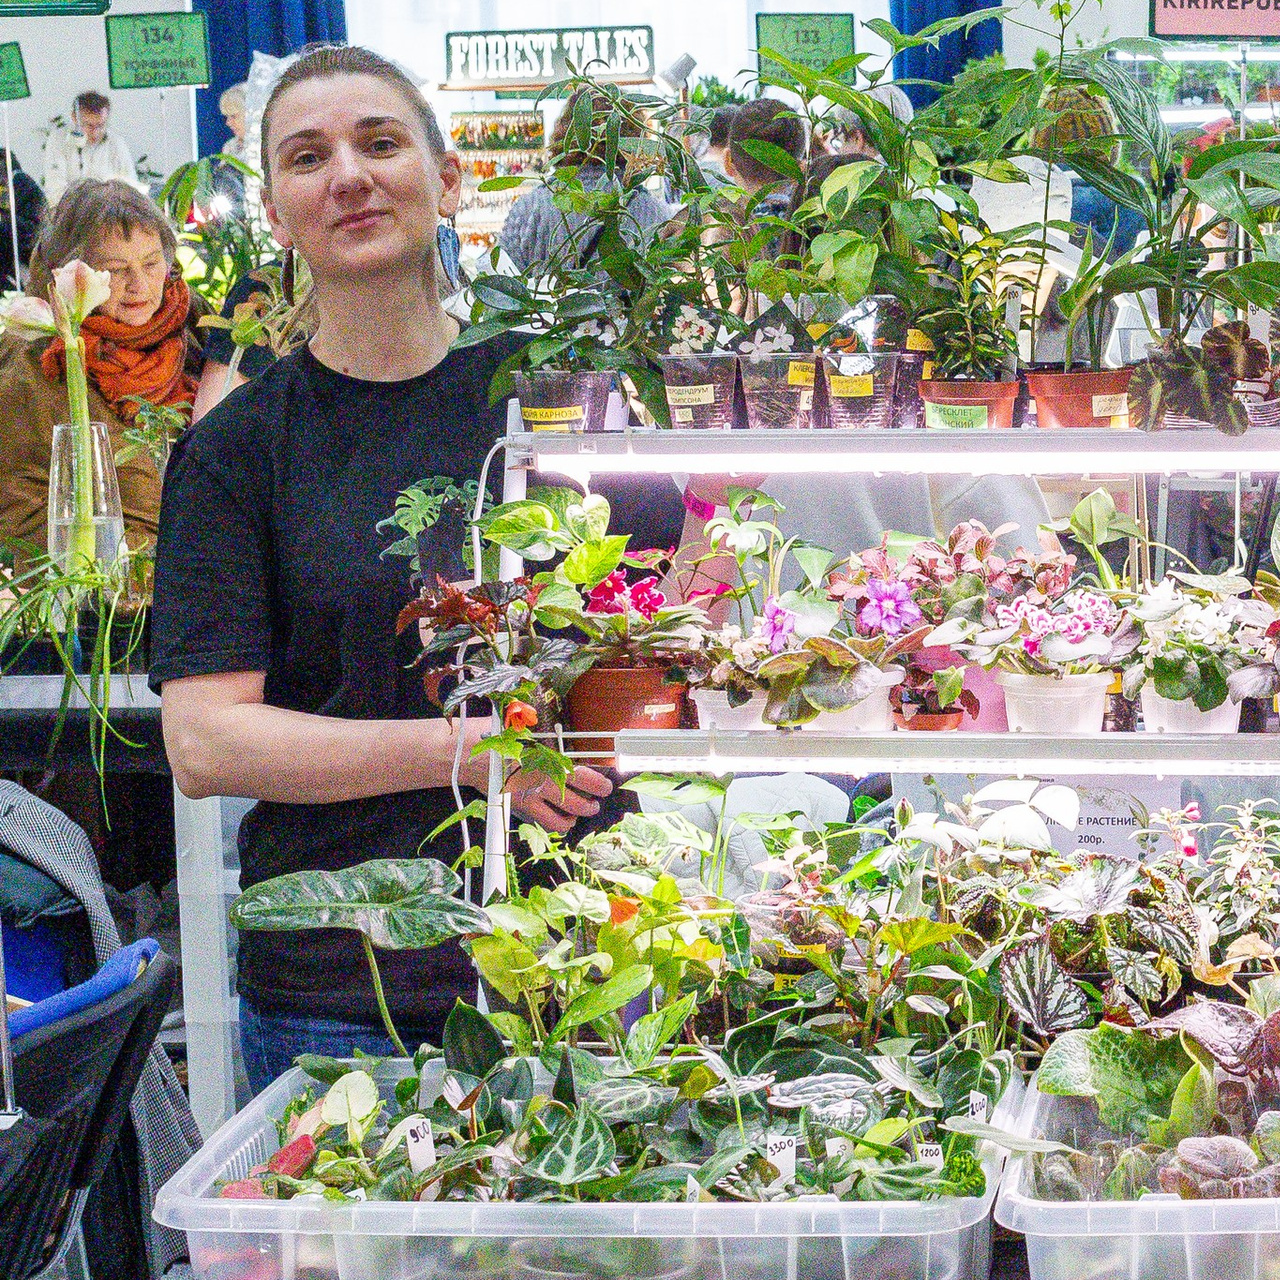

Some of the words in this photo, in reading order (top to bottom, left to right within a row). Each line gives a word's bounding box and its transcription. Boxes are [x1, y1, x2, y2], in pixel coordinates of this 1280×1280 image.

[141, 26, 175, 45] 134
[449, 34, 558, 81] FOREST
[562, 29, 649, 76] TALES
[1086, 816, 1138, 826] РАСТЕНИЕ
[1077, 834, 1106, 846] 200р.
[409, 1120, 430, 1144] 900
[768, 1138, 794, 1157] 3300
[919, 1147, 941, 1158] 1200
